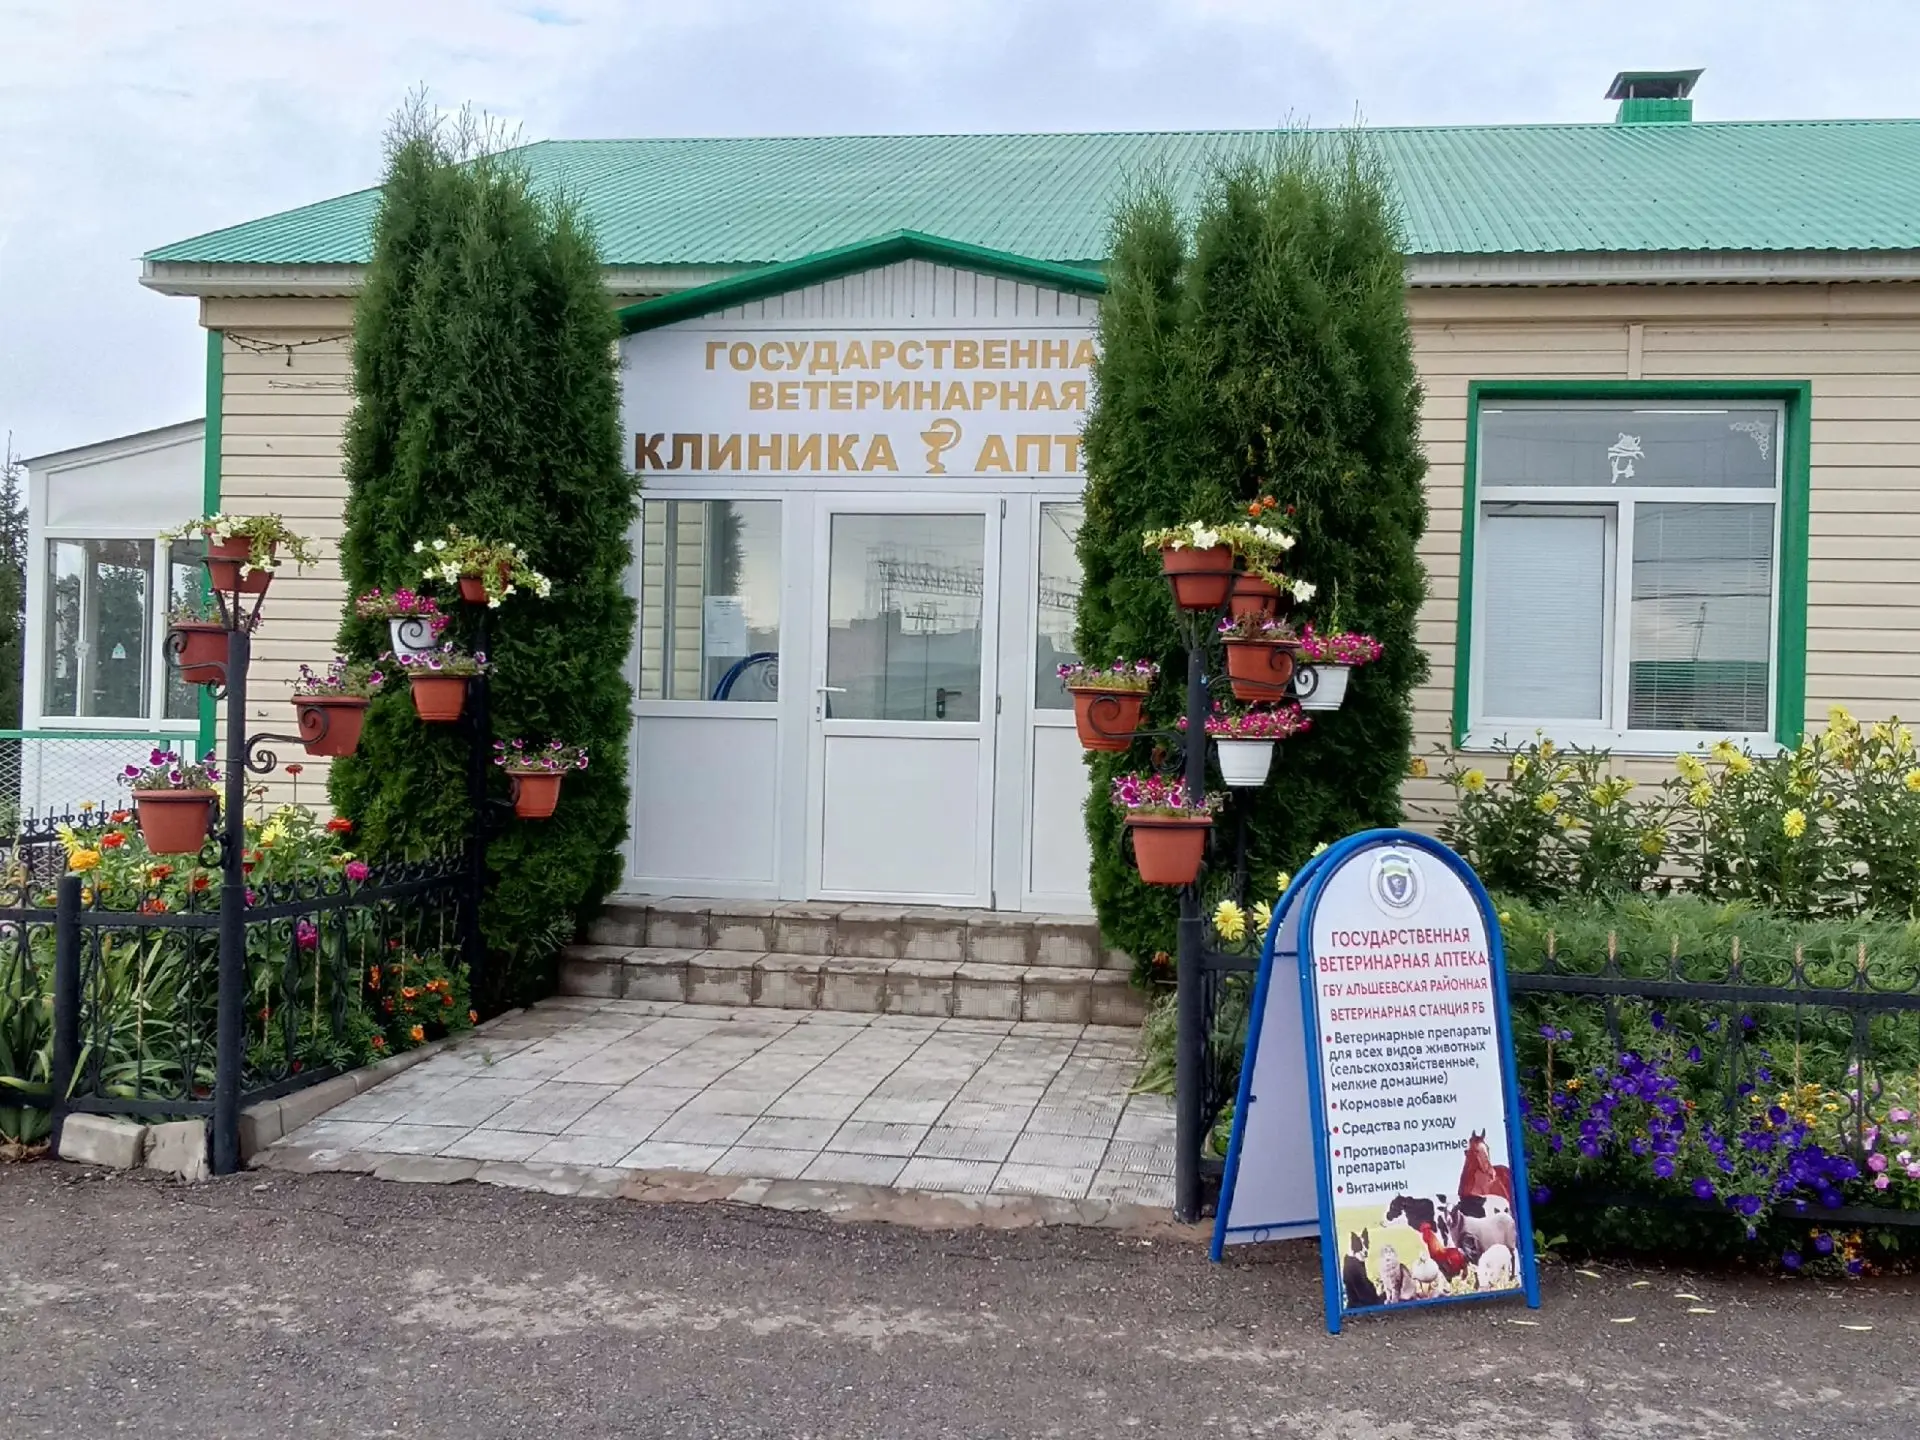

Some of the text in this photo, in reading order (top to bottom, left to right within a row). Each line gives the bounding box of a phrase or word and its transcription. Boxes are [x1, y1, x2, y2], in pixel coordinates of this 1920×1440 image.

[749, 381, 1086, 410] ВЕТЕРИНАРНАЯ
[635, 433, 899, 472] КЛИНИКА
[1332, 928, 1470, 948] ГОСУДАРСТВЕННАЯ
[1319, 951, 1486, 972] ВЕТЕРИНАРНАЯ АПТЕКА
[1323, 975, 1488, 997] ГБУ АЛЬШЕЕВСКАЯ РАЙОННАЯ
[1330, 1002, 1485, 1021] ВЕТЕРИНАРНАЯ СТАНЦИЯ РБ
[1335, 1025, 1491, 1045] Ветеринарные препараты
[1329, 1042, 1486, 1062] для всех видов животных
[1331, 1056, 1479, 1077] (сельскохозяйственные,
[1332, 1071, 1448, 1091] мелкие домашние)
[1340, 1092, 1457, 1113] Кормовые добавки
[1342, 1116, 1456, 1137] Средства по уходу
[1344, 1138, 1467, 1159] Противопаразитные
[1338, 1160, 1405, 1177] препараты
[1346, 1179, 1408, 1194] Витамины
